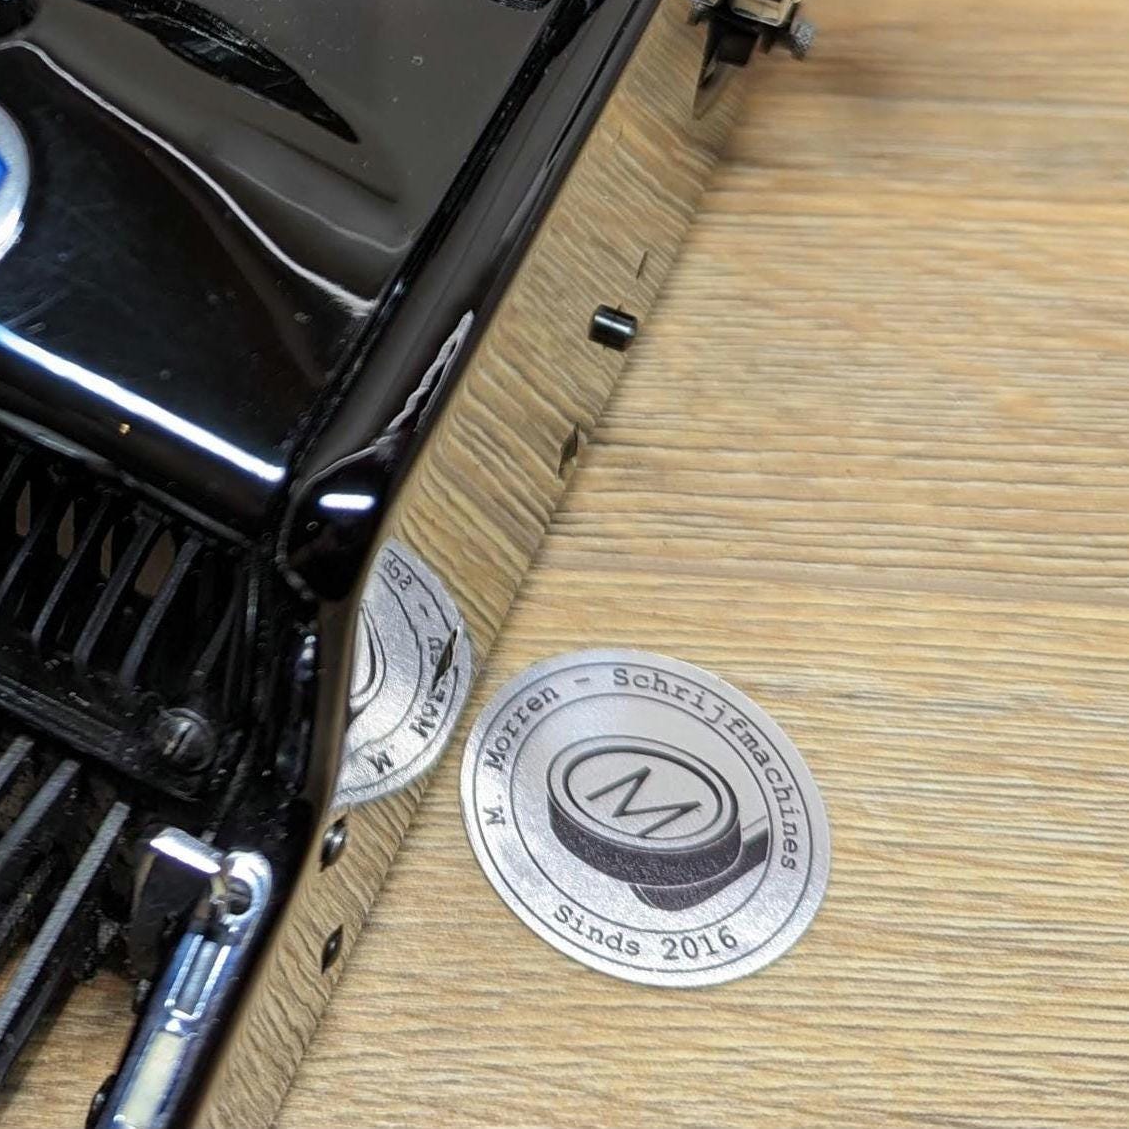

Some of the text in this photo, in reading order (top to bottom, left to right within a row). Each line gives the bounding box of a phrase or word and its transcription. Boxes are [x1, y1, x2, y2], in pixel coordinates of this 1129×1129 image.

[483, 685, 561, 772] Morren
[585, 764, 702, 840] M
[612, 667, 799, 871] Schrijfmachines
[484, 792, 508, 828] M.
[552, 904, 738, 962] Sinds 2016
